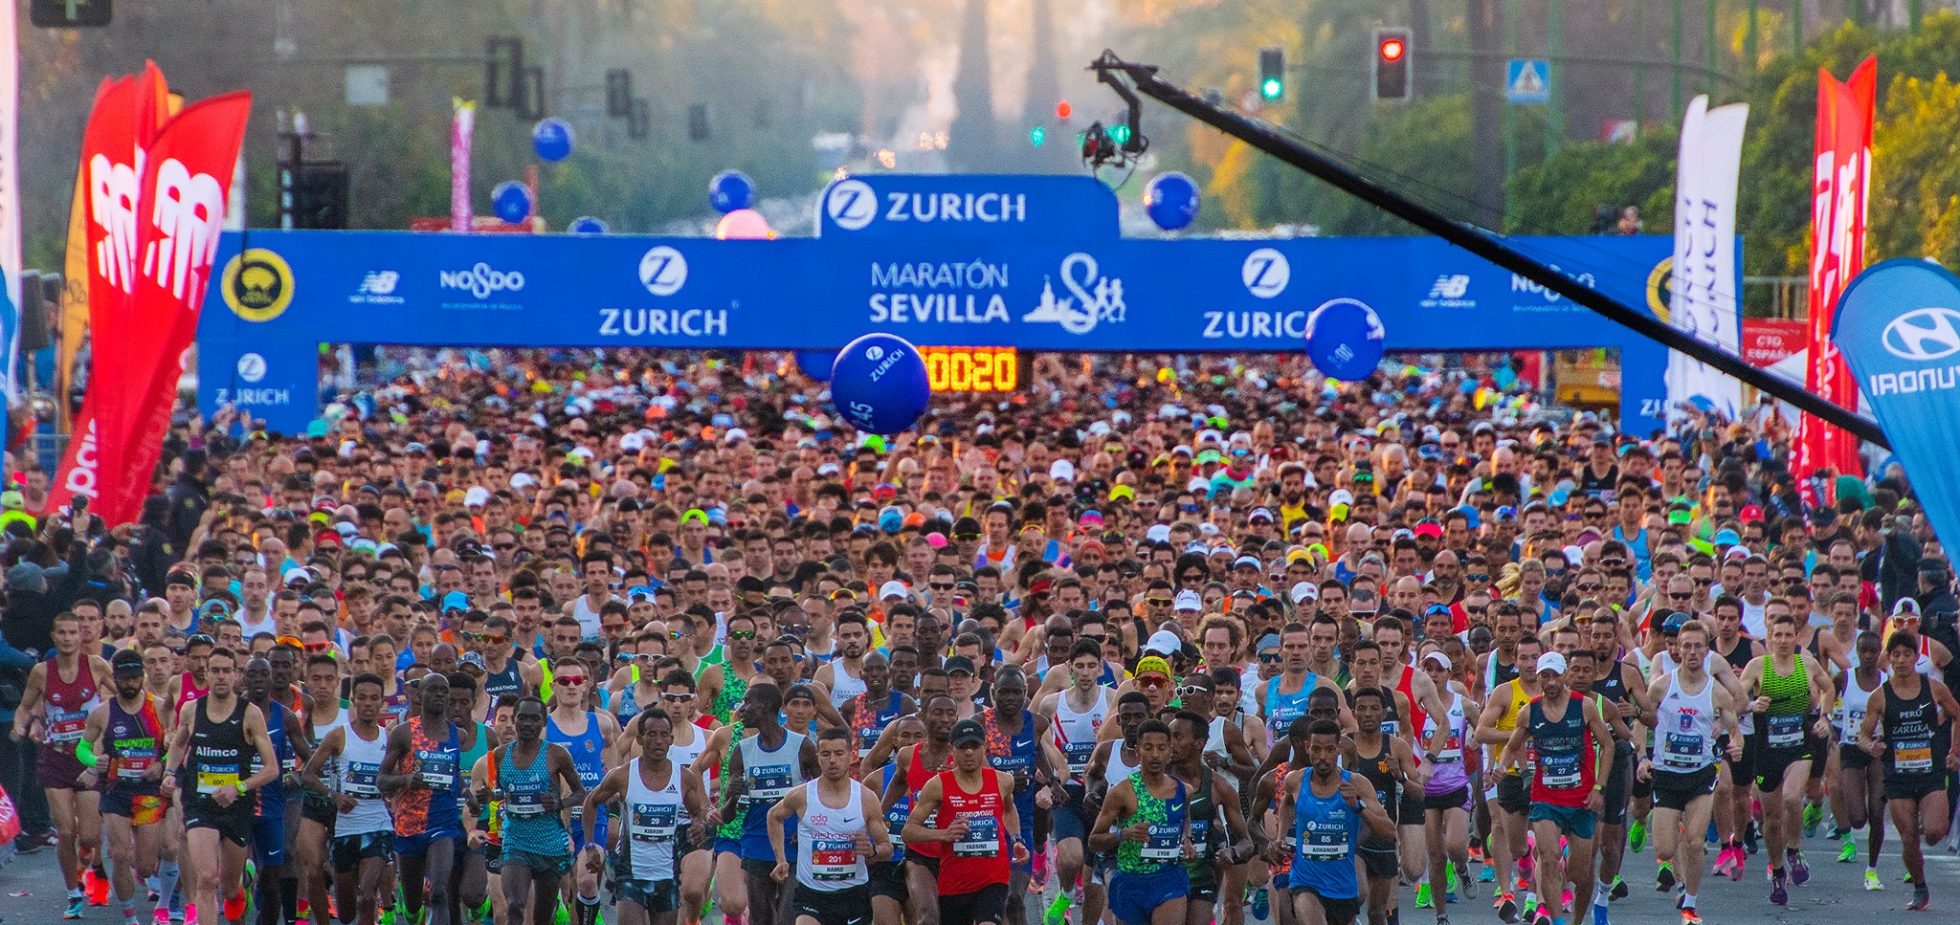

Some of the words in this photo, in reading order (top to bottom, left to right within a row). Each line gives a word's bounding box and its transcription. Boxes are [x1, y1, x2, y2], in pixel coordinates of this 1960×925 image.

[886, 193, 1026, 222] ZURICH
[872, 258, 1008, 289] MARATÓN
[869, 294, 1010, 323] SEVILLA
[599, 308, 727, 337] ZURICH
[1202, 311, 1307, 339] ZURIC
[869, 348, 905, 382] ZURICH
[195, 745, 238, 757] Alimco
[429, 752, 452, 760] ZURICH
[1078, 754, 1087, 762] 47
[433, 764, 439, 772] 5
[761, 767, 787, 775] ZURICH
[968, 819, 993, 827] ZURICH
[972, 832, 982, 840] 32
[1160, 839, 1170, 847] 34
